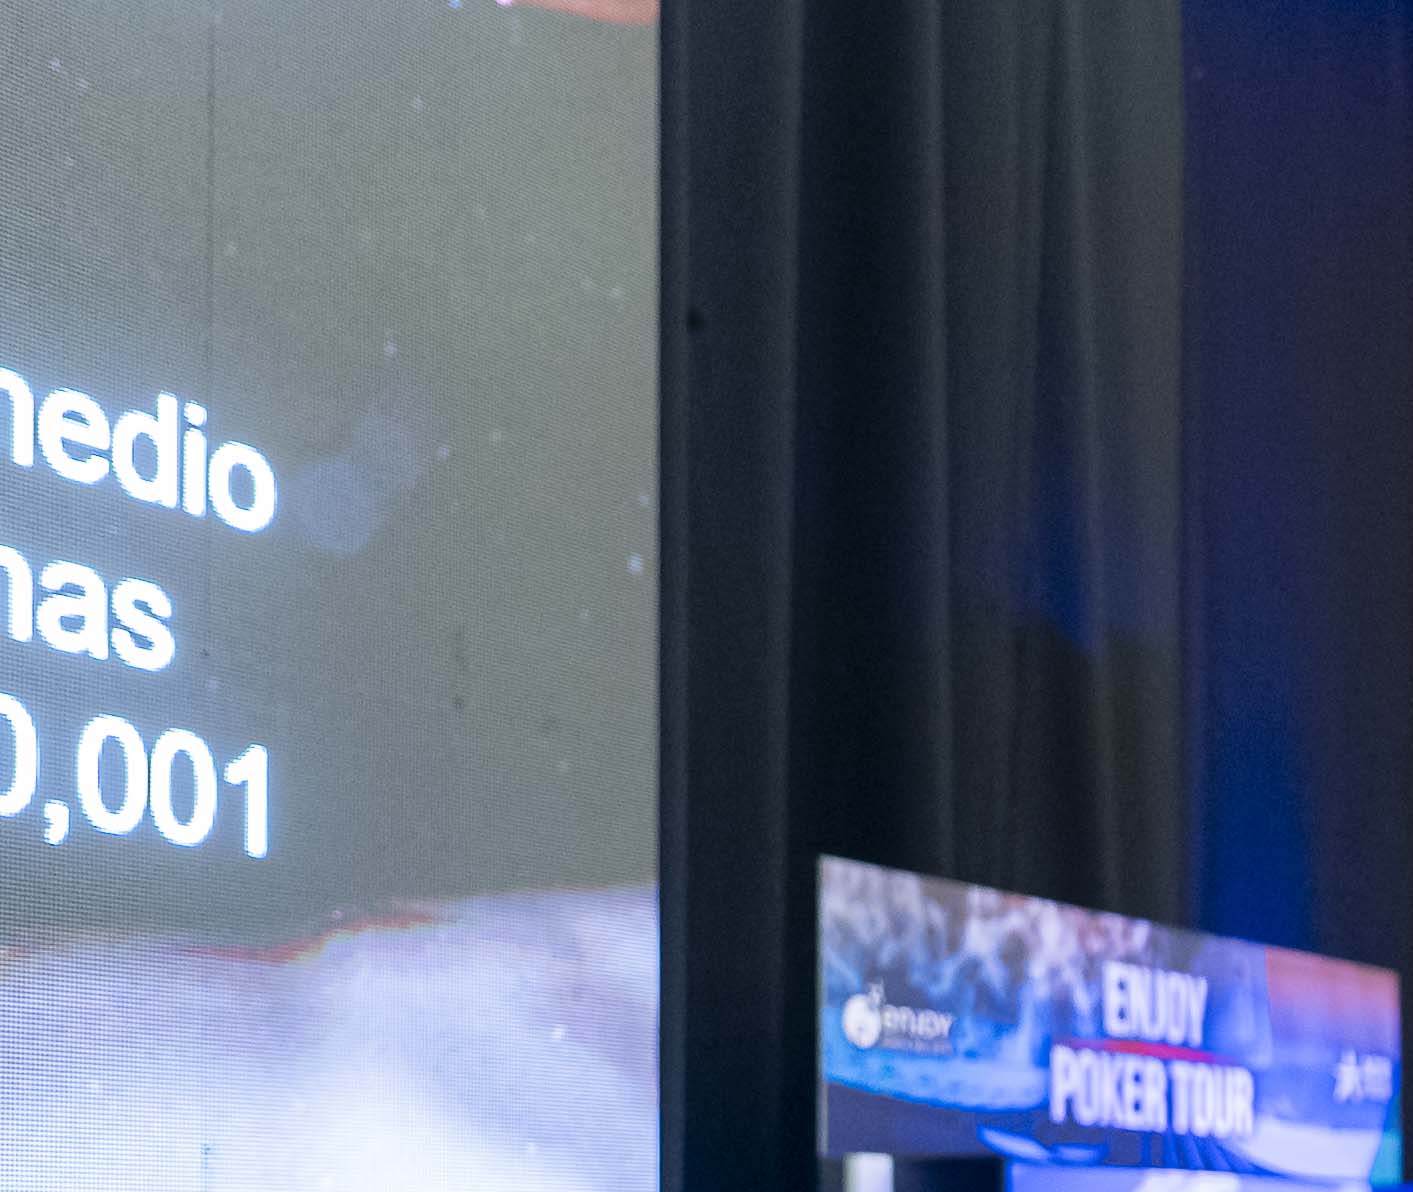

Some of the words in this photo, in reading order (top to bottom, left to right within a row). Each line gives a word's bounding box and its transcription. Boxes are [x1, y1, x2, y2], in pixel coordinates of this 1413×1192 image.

[1102, 960, 1208, 1049] ENJOY
[1051, 1044, 1168, 1134] POKER
[1171, 1058, 1255, 1139] TOUR
